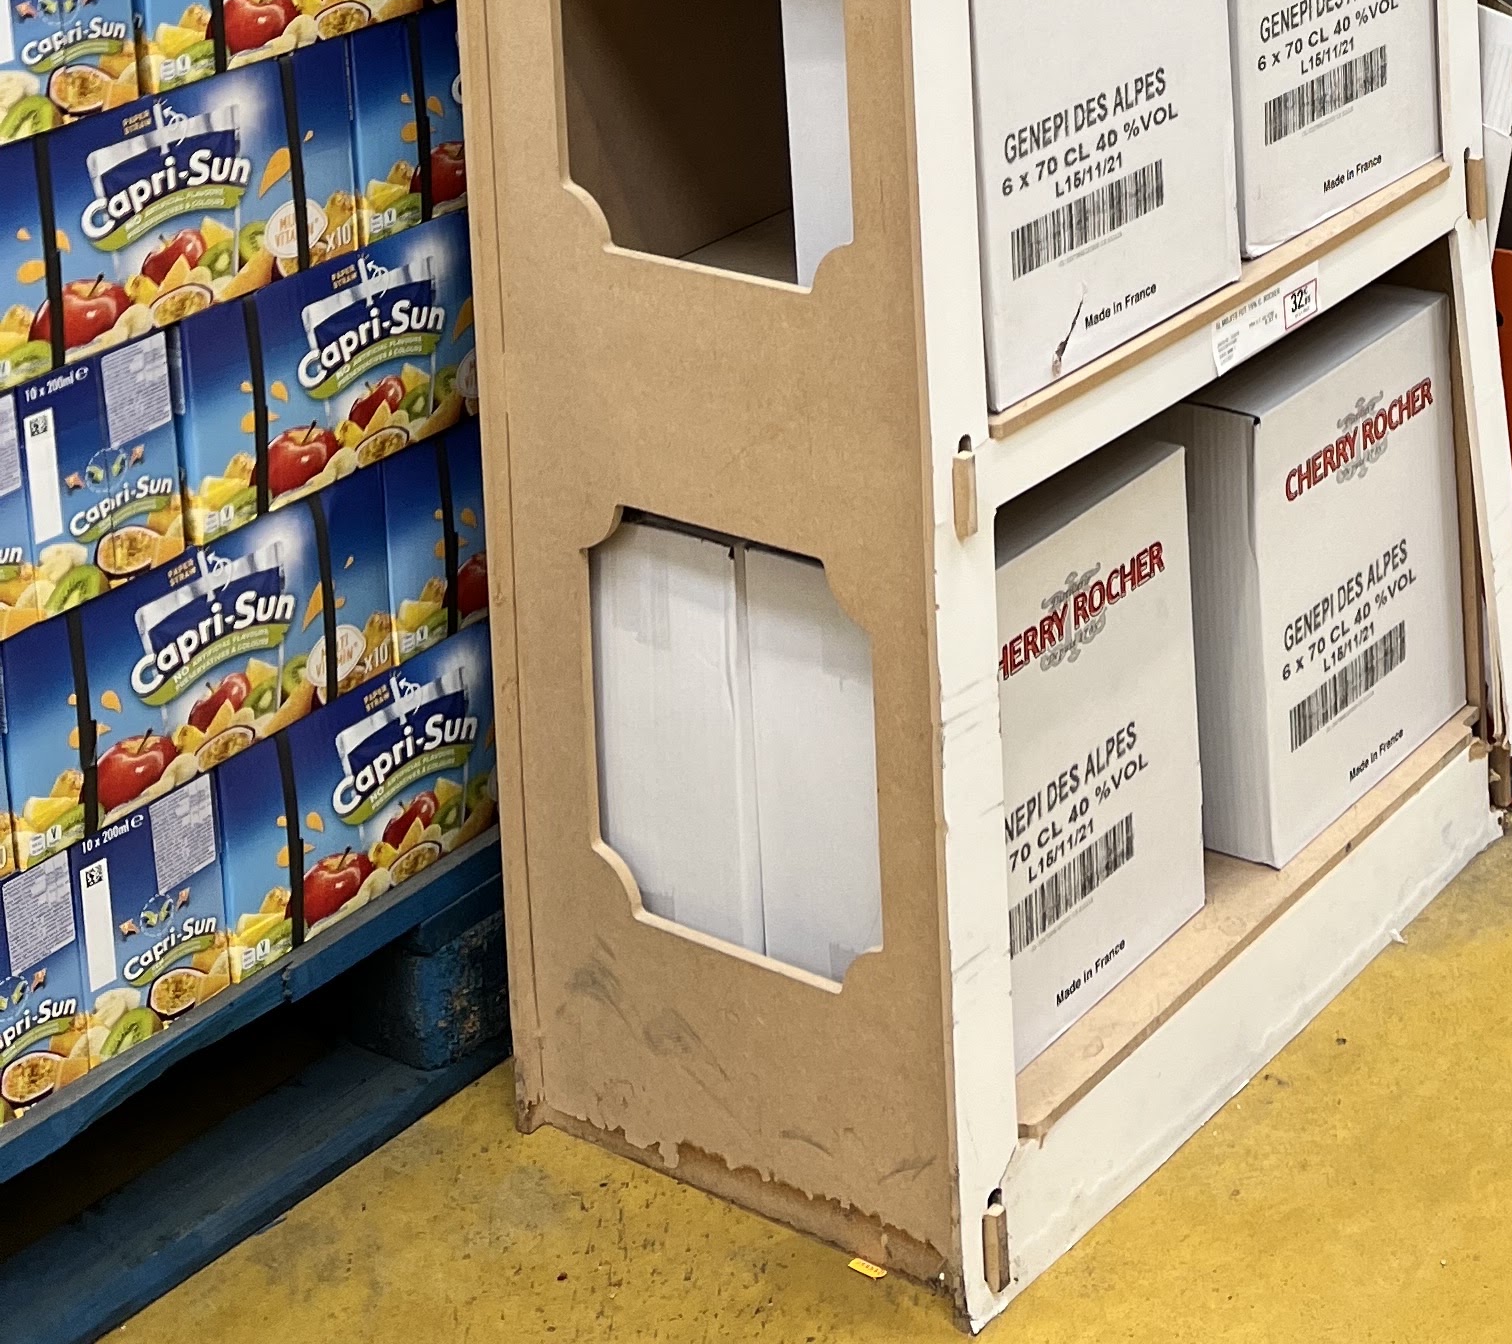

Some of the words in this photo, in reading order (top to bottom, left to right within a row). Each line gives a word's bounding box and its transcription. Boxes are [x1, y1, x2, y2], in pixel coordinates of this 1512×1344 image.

[21, 16, 127, 67] Capri-Sun
[1257, 55, 1267, 73] 6
[1271, 50, 1281, 67] x
[1284, 37, 1304, 61] 70
[1307, 25, 1329, 49] CL
[1333, 16, 1352, 39] 40
[1259, 0, 1312, 45] GENEPI
[1003, 108, 1070, 165] GENEPI
[1072, 90, 1109, 133] DES
[1112, 66, 1168, 118] ALPES
[80, 148, 252, 240] Capri-Sun
[1001, 176, 1014, 197] 6
[1018, 170, 1031, 191] x
[1035, 155, 1059, 183] 70
[1063, 142, 1091, 169] CL
[1095, 128, 1118, 152] 40
[1322, 173, 1345, 194] Made
[1356, 153, 1383, 175] France
[1083, 306, 1111, 330] Made
[1124, 282, 1158, 310] France
[297, 298, 446, 389] Capri-Sun
[1285, 429, 1359, 503] CHERRY
[1361, 375, 1434, 452] ROCHER
[69, 472, 173, 537] Capri-Sun
[1000, 602, 1070, 682] HERRY
[1073, 540, 1166, 620] ROCHER
[1283, 592, 1335, 654] GENEPI
[1336, 570, 1364, 613] DES
[1366, 537, 1410, 590] ALPES
[130, 590, 297, 697] Capri-Sun
[172, 666, 191, 684] NO
[1281, 662, 1292, 682] 6
[1296, 651, 1305, 671] x
[1308, 638, 1327, 664] 70
[1329, 619, 1351, 647] CL
[1353, 603, 1372, 626] 40
[332, 713, 479, 815] Capri-Sun
[1004, 792, 1041, 846] NEPI
[1045, 763, 1080, 812] DES
[1084, 720, 1138, 785] ALPES
[1348, 758, 1370, 782] Made
[1379, 727, 1405, 756] France
[81, 840, 94, 855] 10
[94, 838, 101, 849] x
[101, 819, 130, 845] 200ml
[1008, 841, 1030, 873] 70
[1035, 820, 1063, 850] CL
[1068, 795, 1090, 825] 40
[122, 915, 217, 982] Capri-Sun
[1055, 978, 1081, 1008] Made
[1094, 938, 1127, 975] France
